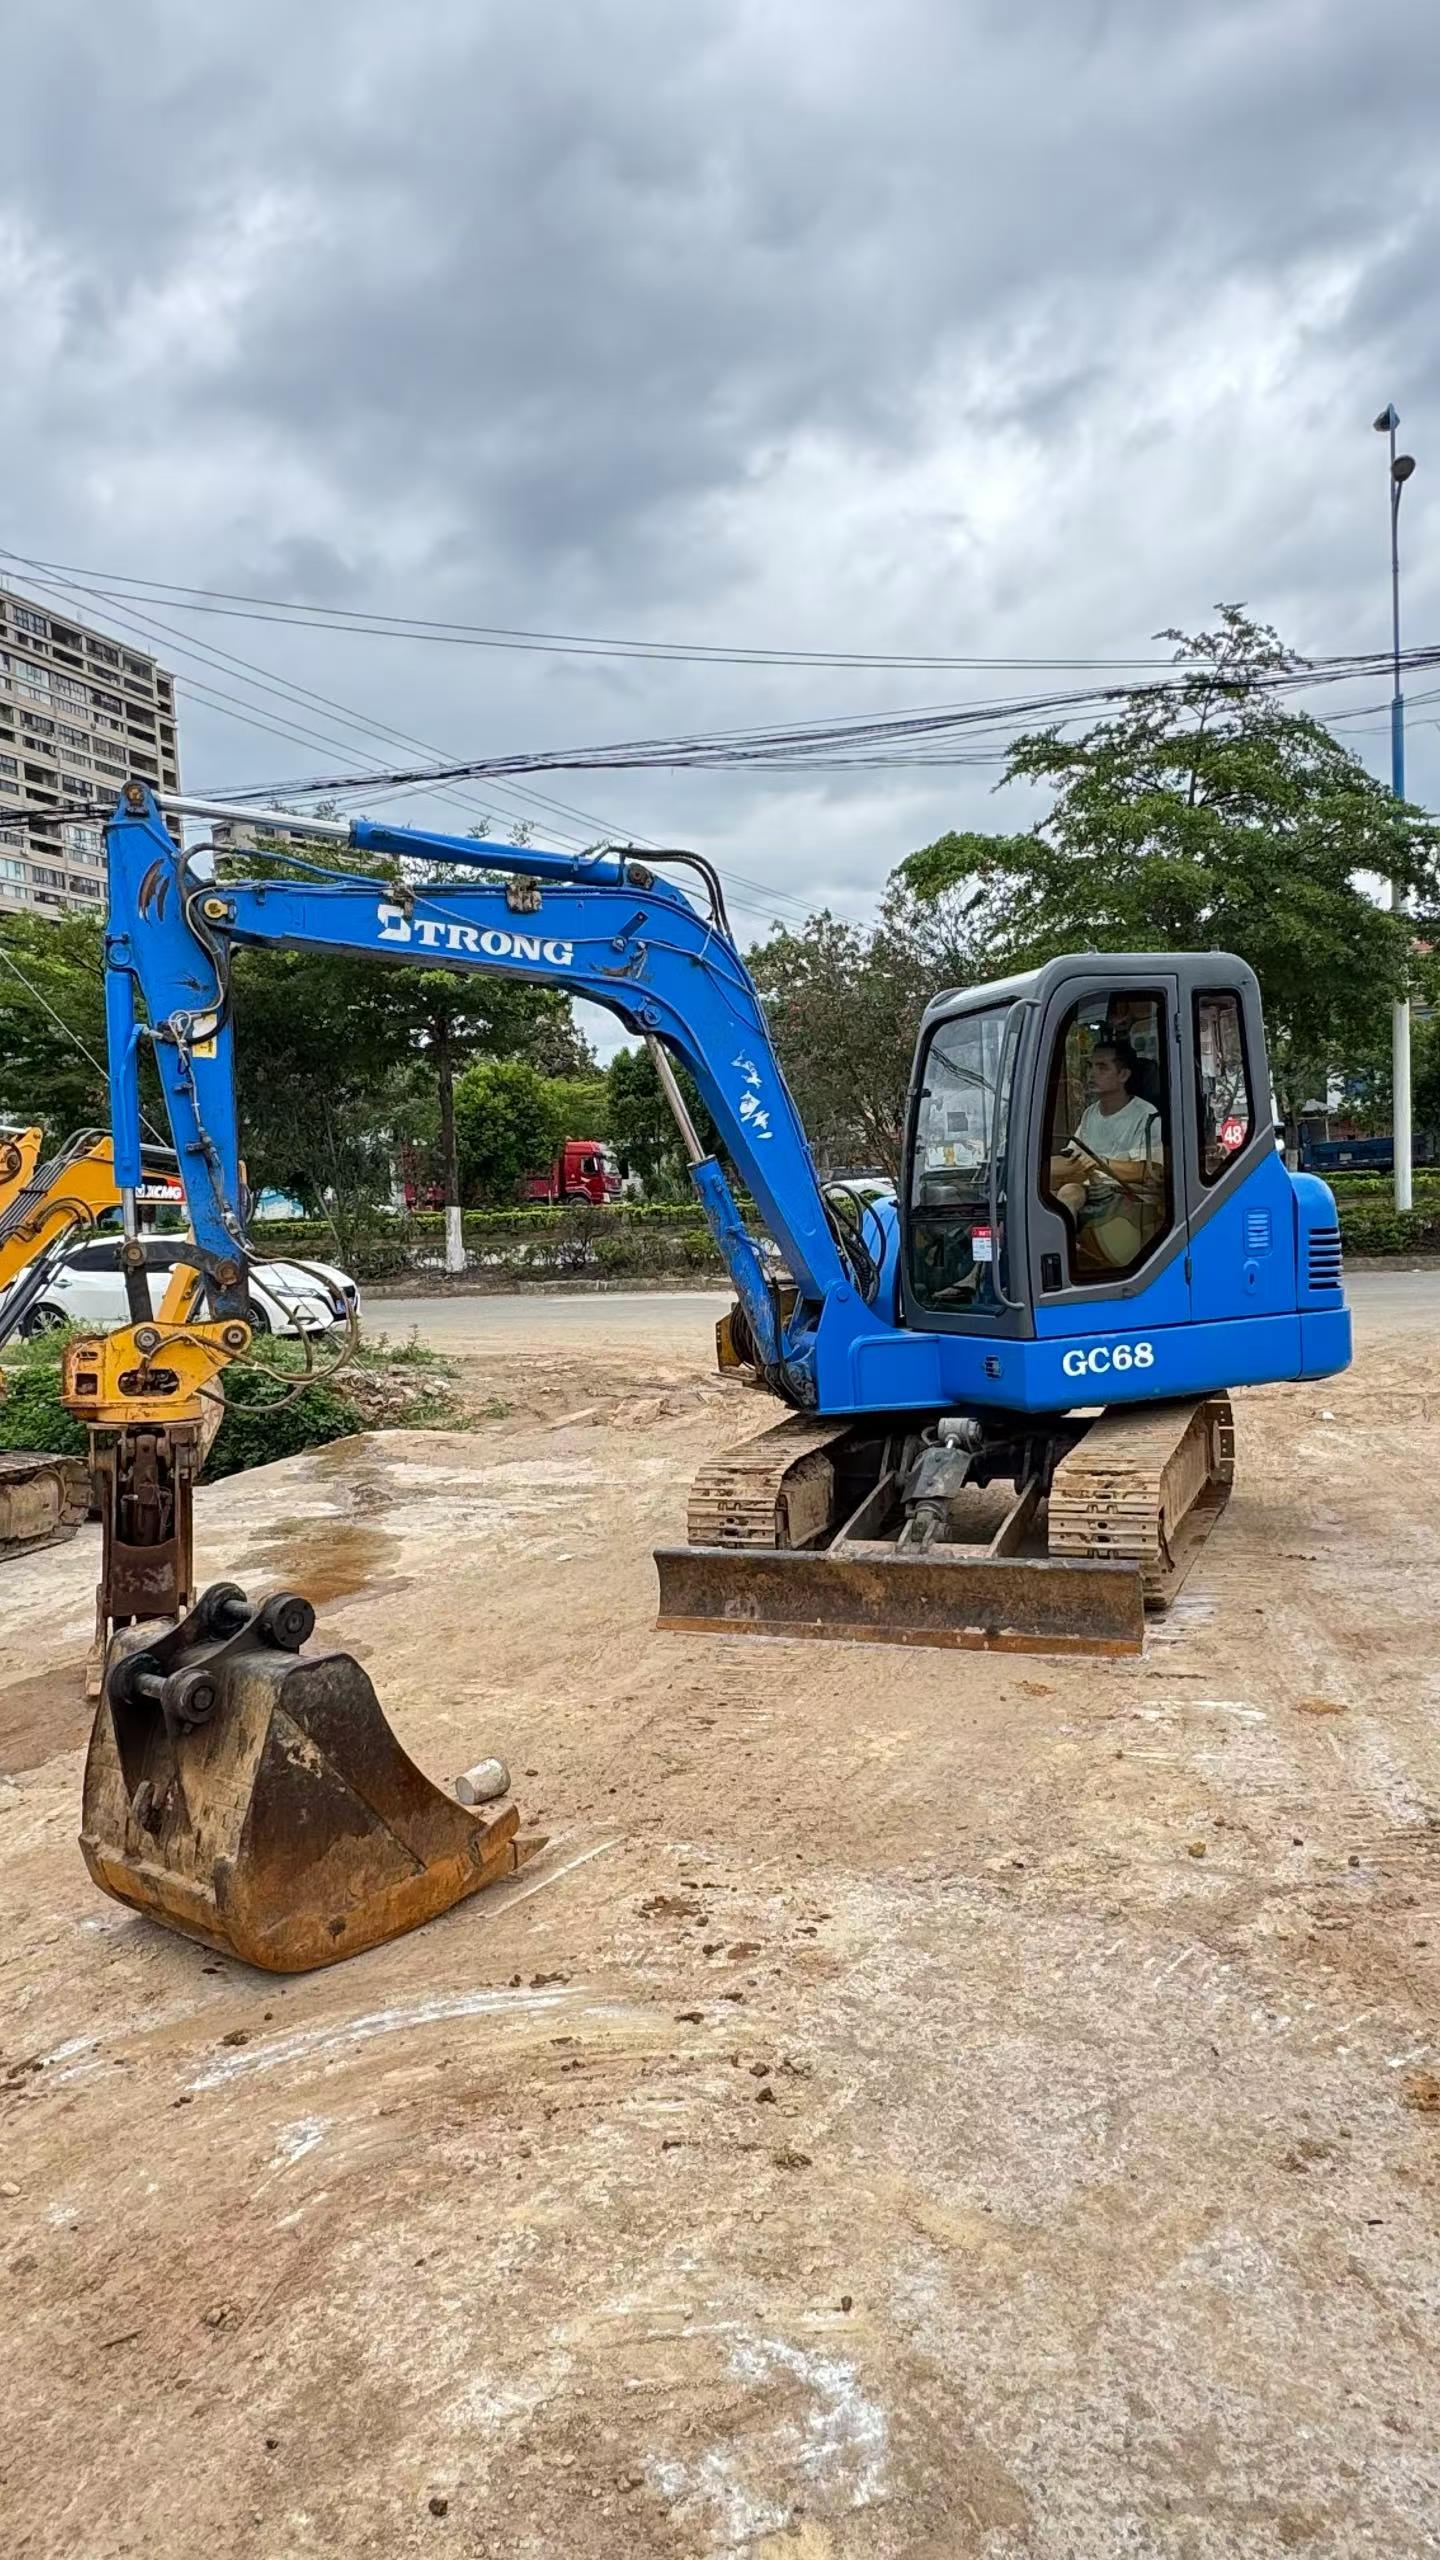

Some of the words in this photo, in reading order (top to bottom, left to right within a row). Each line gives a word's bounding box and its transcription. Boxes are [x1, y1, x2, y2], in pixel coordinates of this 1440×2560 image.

[377, 904, 574, 965] STRONG
[1224, 1125, 1242, 1144] 48
[145, 1184, 182, 1200] XCMG
[1062, 1342, 1155, 1376] GC68
